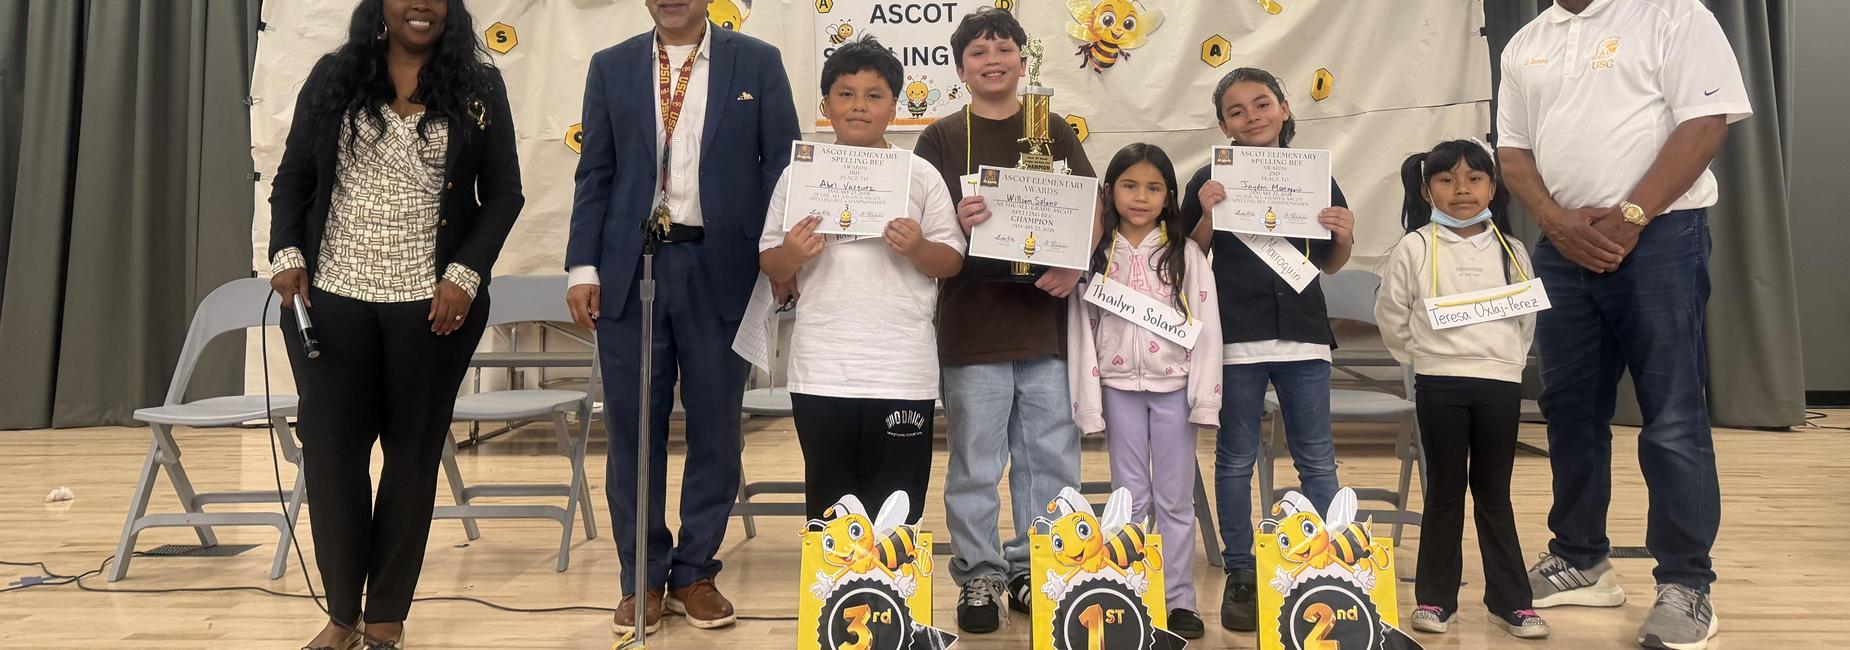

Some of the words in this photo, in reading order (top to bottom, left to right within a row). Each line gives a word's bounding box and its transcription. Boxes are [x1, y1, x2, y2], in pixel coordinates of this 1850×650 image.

[869, 2, 958, 24] ASCOT
[496, 31, 508, 43] S
[823, 46, 949, 66] SING
[1210, 44, 1221, 57] A
[1592, 59, 1614, 70] USC
[660, 63, 670, 84] USC
[675, 76, 689, 97] USC
[668, 111, 679, 134] USC
[822, 148, 846, 156] ASCOT
[849, 150, 898, 160] ELEMENTARY
[831, 156, 868, 165] SPELLING
[1240, 150, 1266, 158] ASCOT
[1267, 151, 1317, 160] ELEMENTARY
[1250, 158, 1288, 166] SPELLING
[820, 179, 837, 189] Abel
[1003, 174, 1030, 182] ASCOT
[1031, 177, 1084, 189] ELEMENTARY
[1024, 185, 1059, 195] AWARDS
[1007, 194, 1033, 205] William
[1034, 197, 1058, 206] Solano
[1012, 209, 1040, 217] SPELLING
[1011, 216, 1054, 226] CHAMPION
[1262, 237, 1300, 281] Marroquin
[1093, 284, 1135, 314] Thailyn
[1143, 307, 1187, 339] Solano
[1429, 307, 1472, 326] Teresa
[1474, 296, 1539, 318] Oxlaj-Perez
[838, 604, 892, 650] 3rd
[1078, 604, 1125, 650] 1ST
[1303, 603, 1359, 650] 2nd
